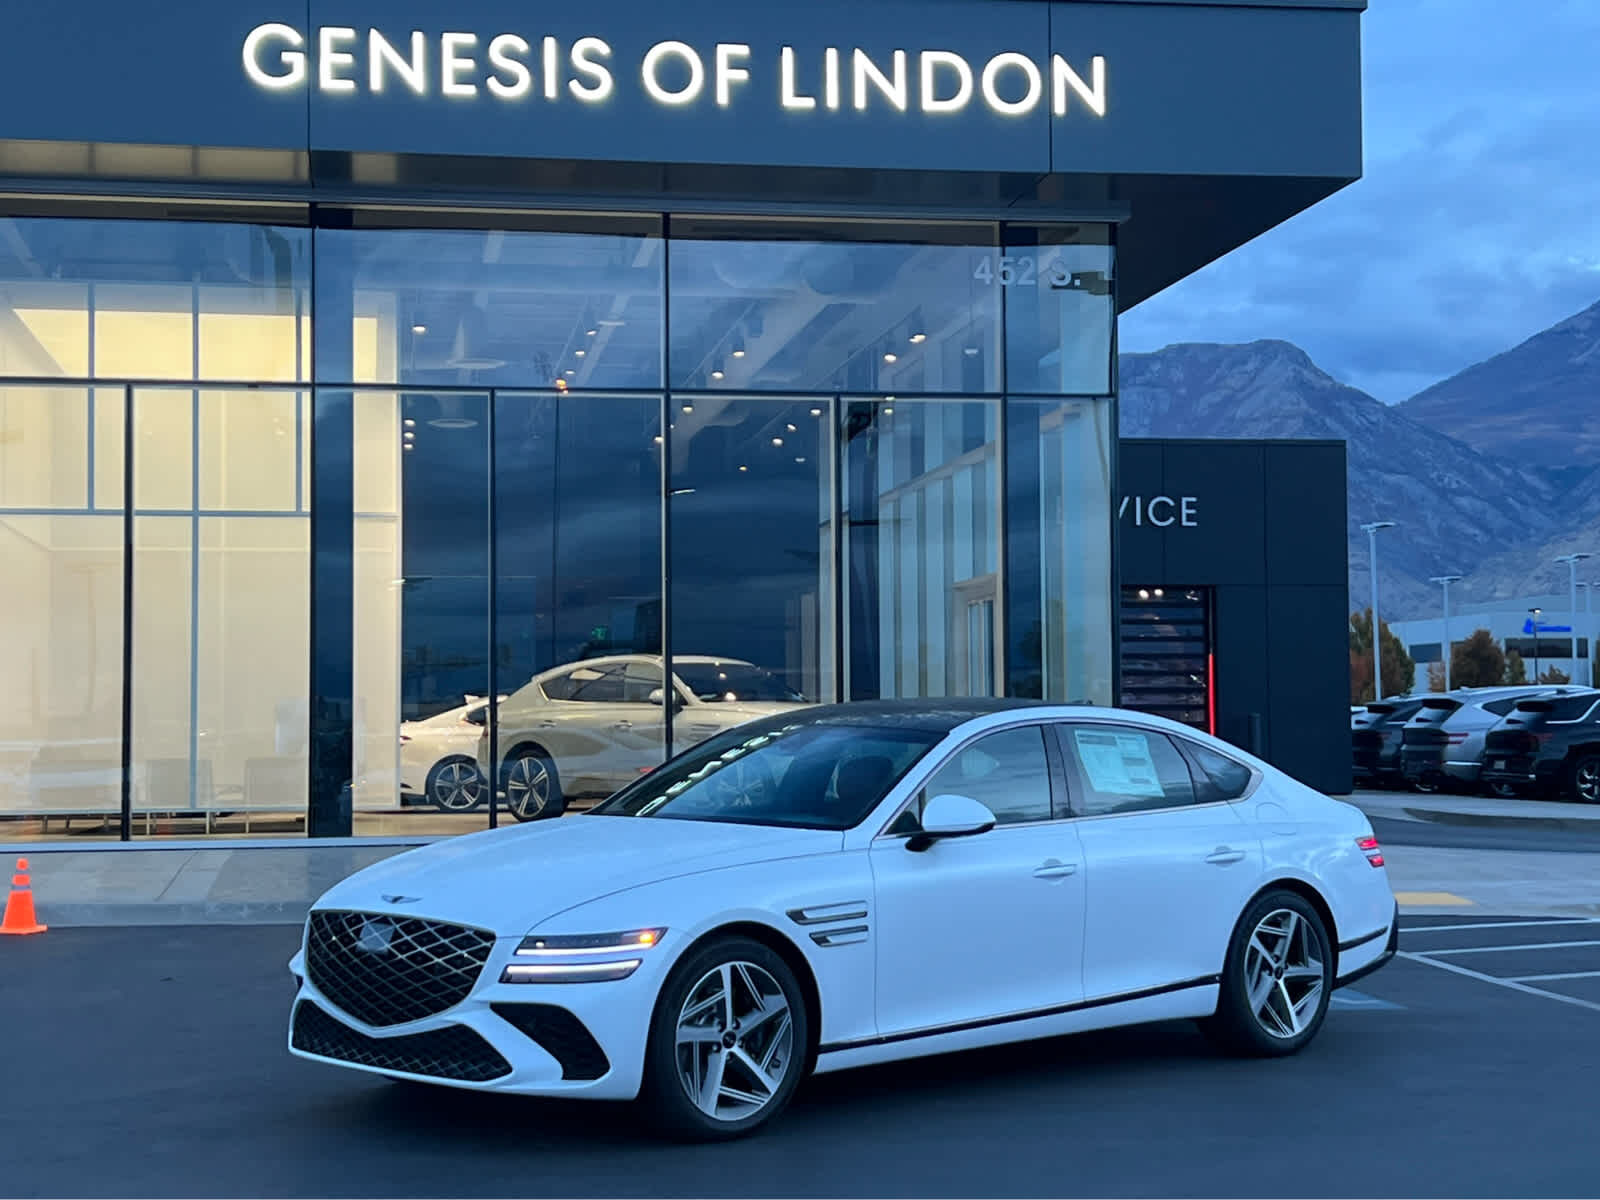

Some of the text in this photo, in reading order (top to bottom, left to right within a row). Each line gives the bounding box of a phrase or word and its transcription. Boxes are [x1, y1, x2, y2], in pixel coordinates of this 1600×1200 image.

[242, 23, 1107, 117] GENESIS OF LINDON
[973, 255, 1036, 286] 452
